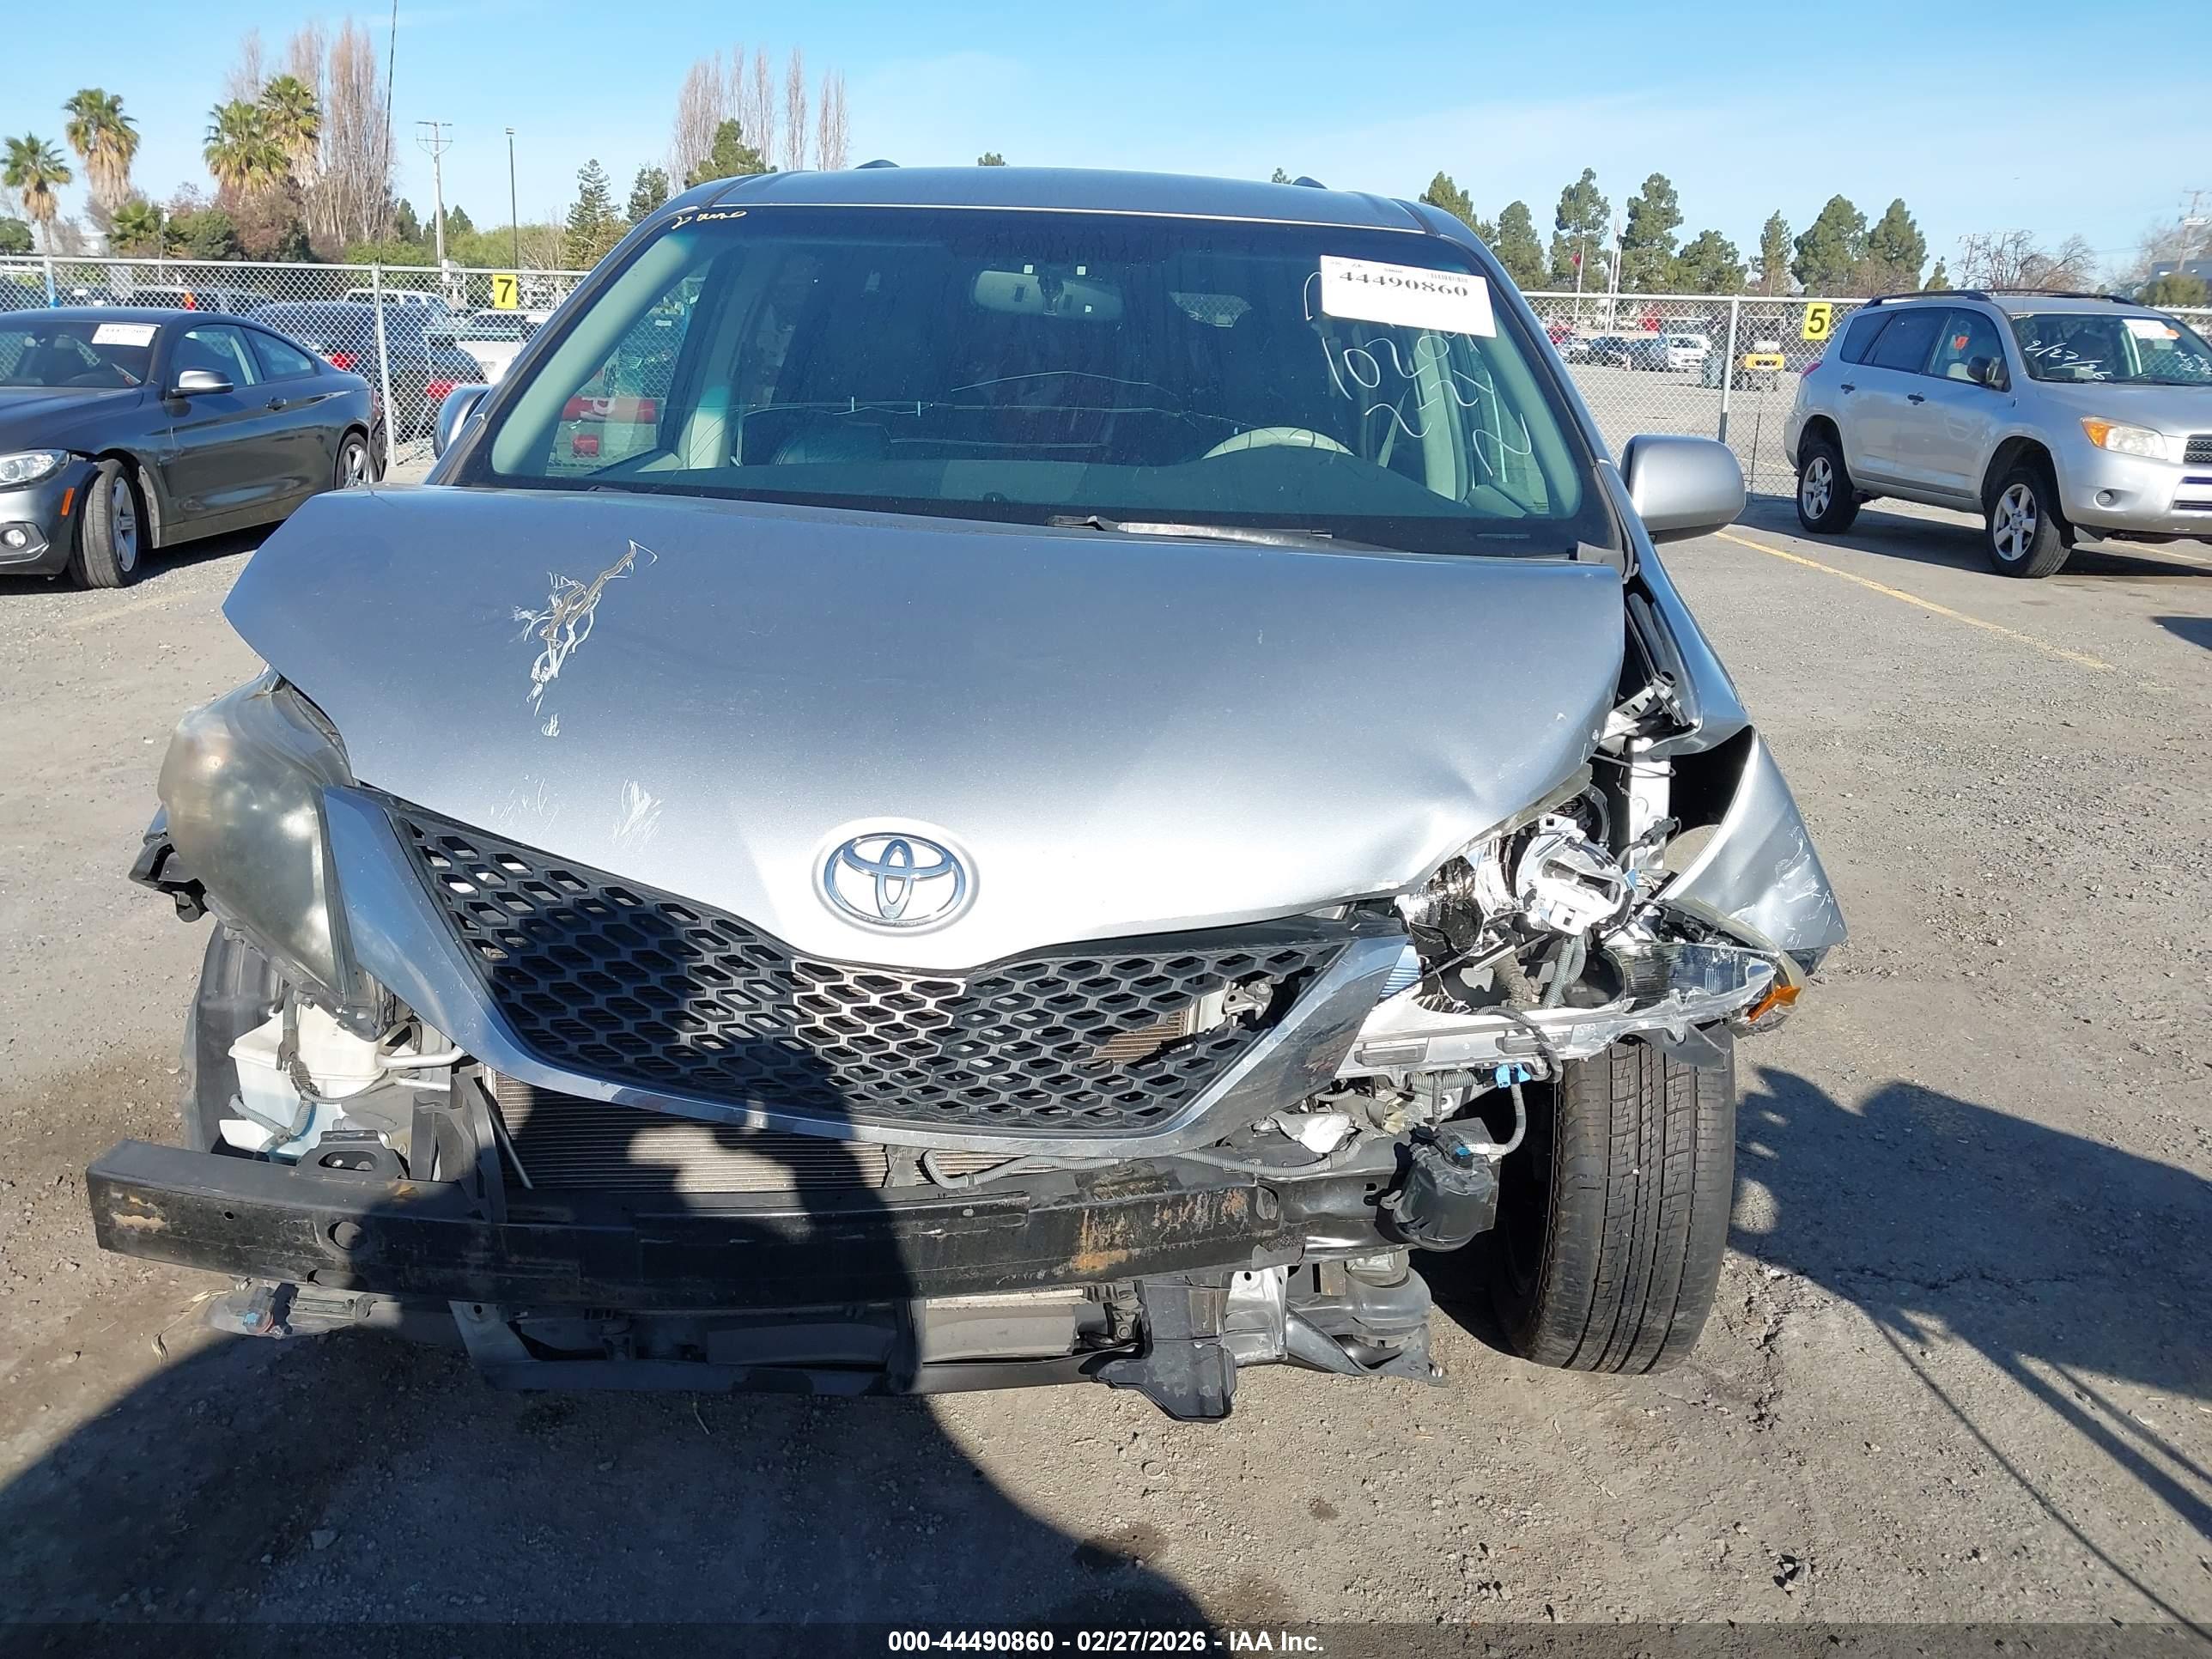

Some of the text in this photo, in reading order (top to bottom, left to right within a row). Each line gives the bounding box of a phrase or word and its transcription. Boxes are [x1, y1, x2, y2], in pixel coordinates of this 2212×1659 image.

[497, 278, 513, 303] 7
[1339, 270, 1468, 297] 44490860
[1808, 308, 1826, 333] 5
